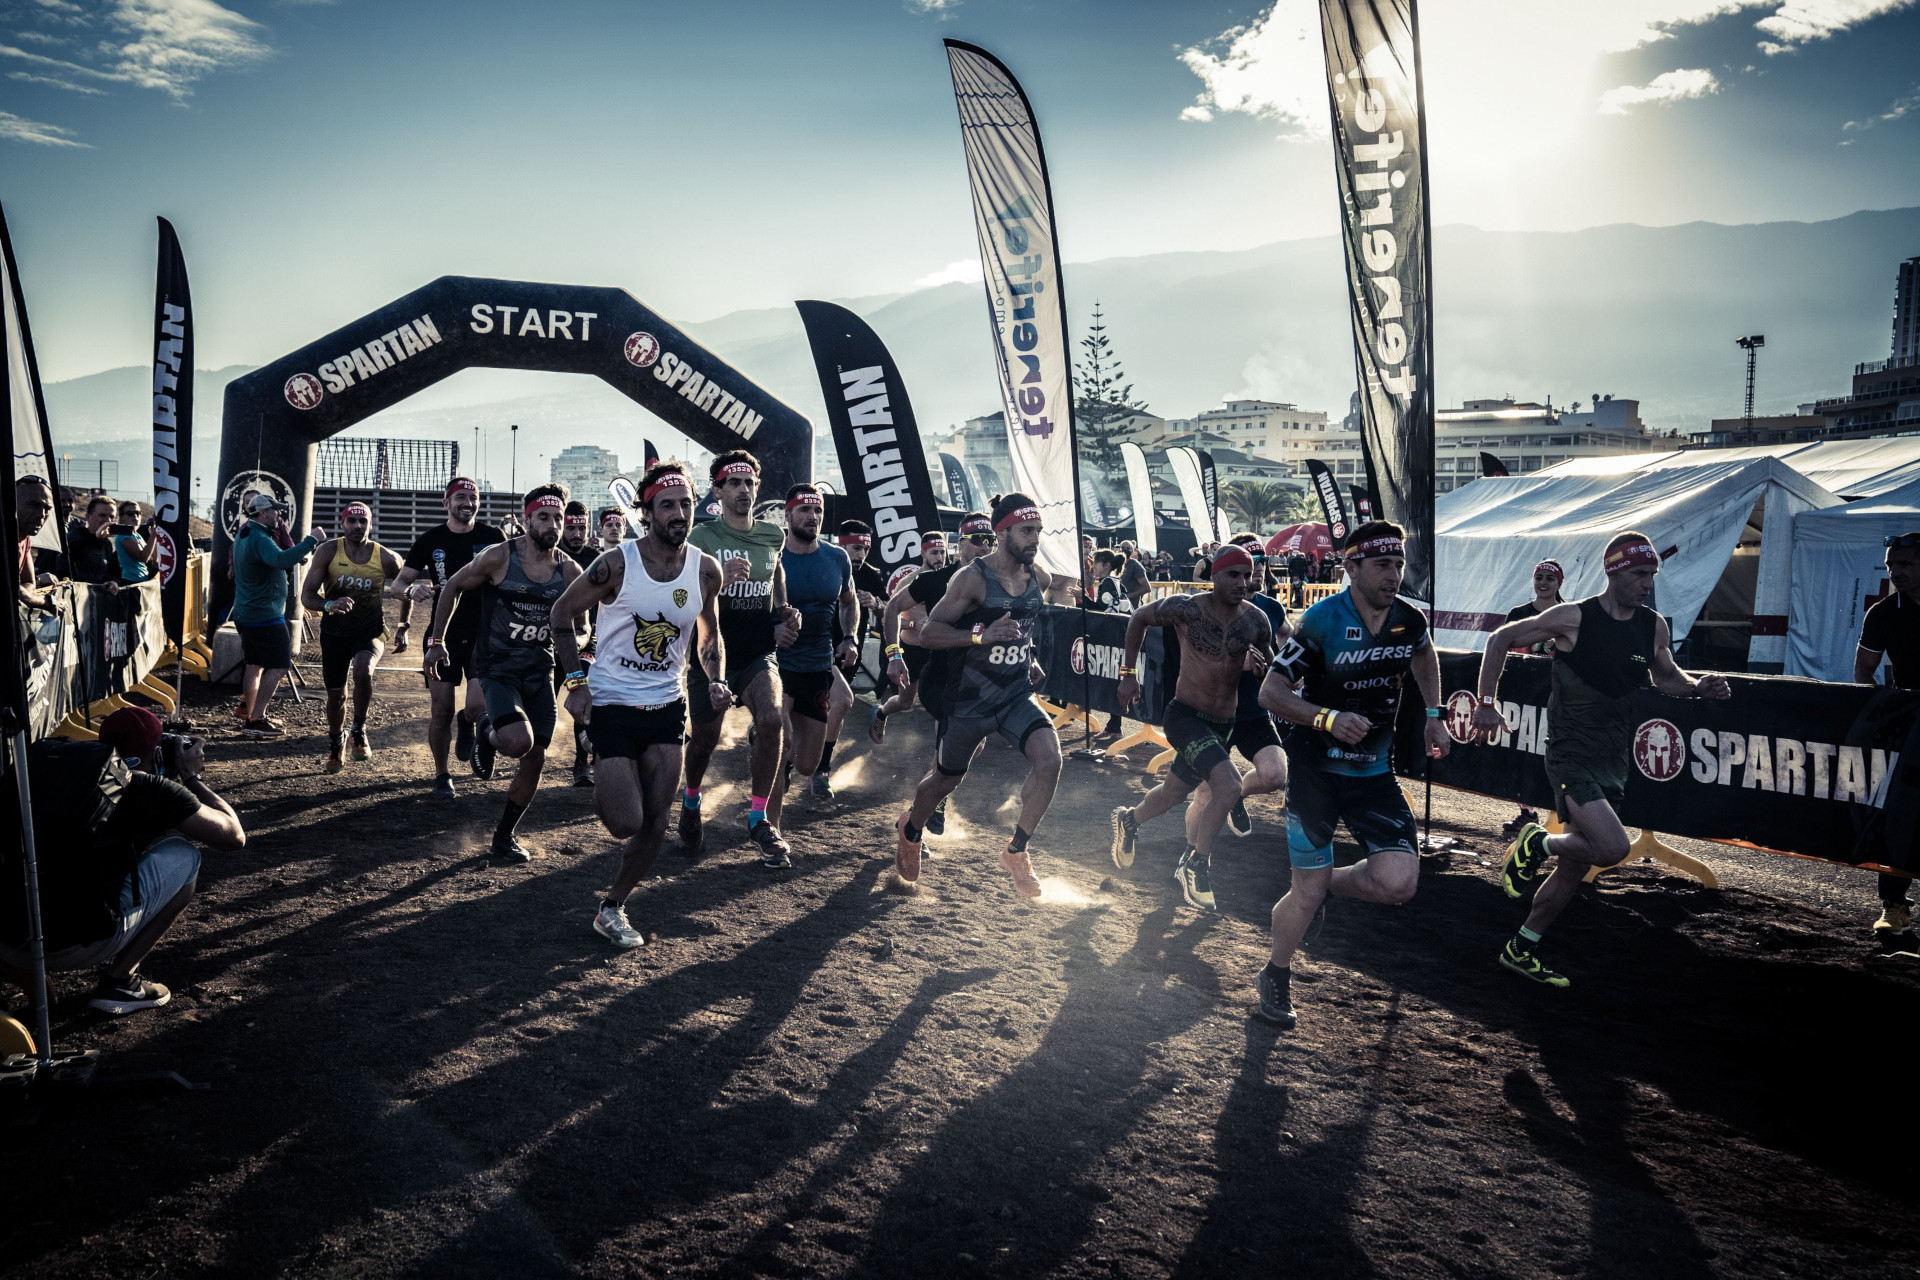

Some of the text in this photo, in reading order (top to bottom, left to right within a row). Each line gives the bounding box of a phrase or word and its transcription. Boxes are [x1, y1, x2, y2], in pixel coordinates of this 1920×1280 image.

[470, 302, 598, 341] START
[317, 312, 443, 395] SPARTAN
[154, 302, 186, 523] SPARTAN
[653, 351, 765, 441] SPARTAN
[839, 365, 922, 564] SPARTAN
[1317, 471, 1342, 524] SPARTAN
[337, 574, 373, 592] 1238
[509, 621, 548, 642] 786
[1333, 644, 1413, 665] INVERSE
[1347, 628, 1360, 640] IN
[1087, 643, 1147, 686] SPARTN
[1689, 728, 1901, 809] SPARTAN
